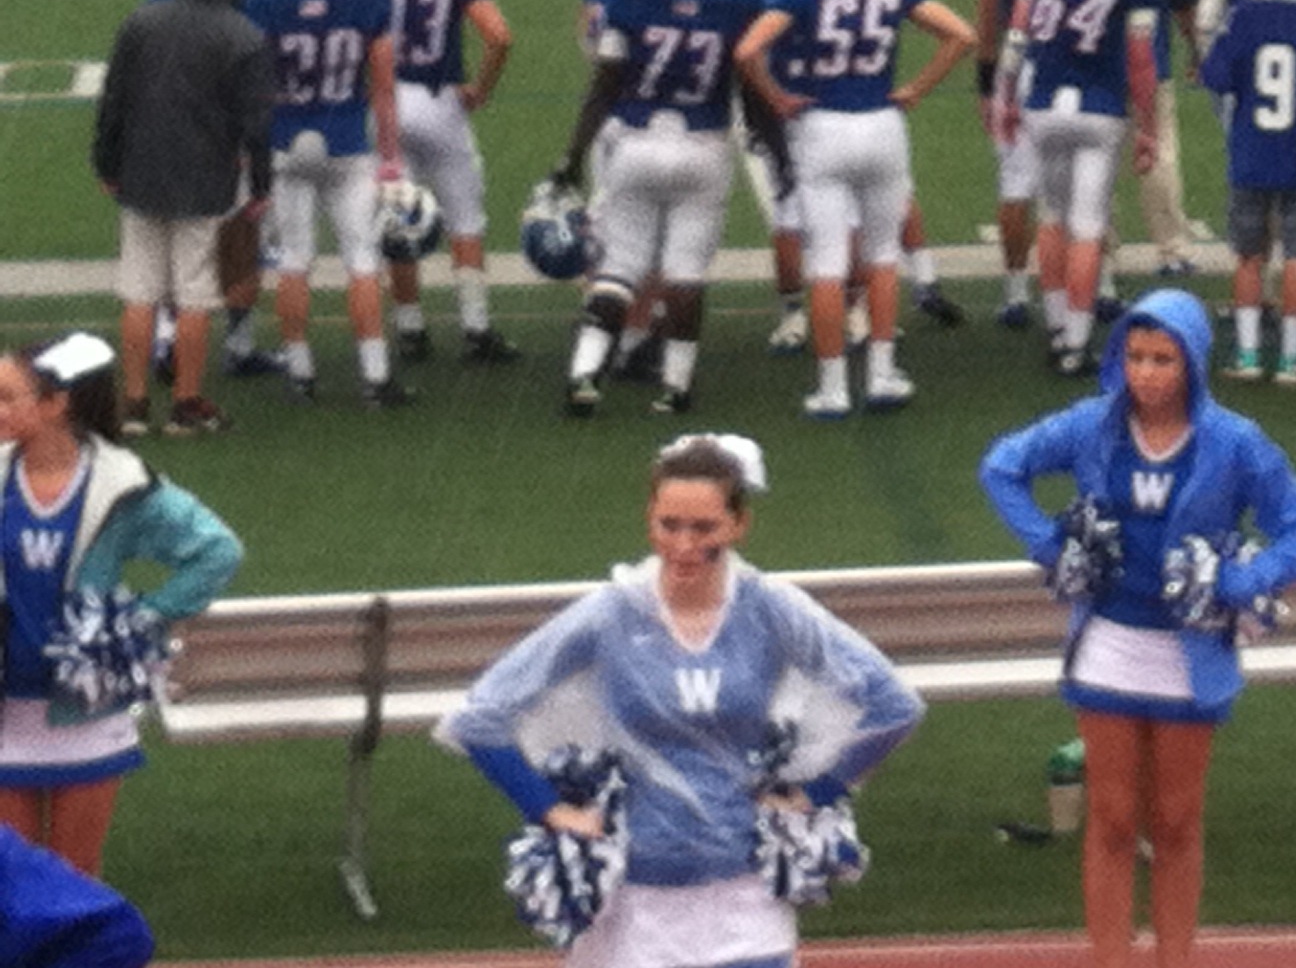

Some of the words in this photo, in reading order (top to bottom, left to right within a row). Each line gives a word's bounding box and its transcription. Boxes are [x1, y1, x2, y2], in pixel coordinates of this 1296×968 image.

[280, 28, 363, 102] 20
[637, 26, 722, 104] 73
[1255, 43, 1296, 130] 9
[1132, 471, 1175, 512] W
[20, 528, 64, 569] W
[674, 668, 724, 712] W
